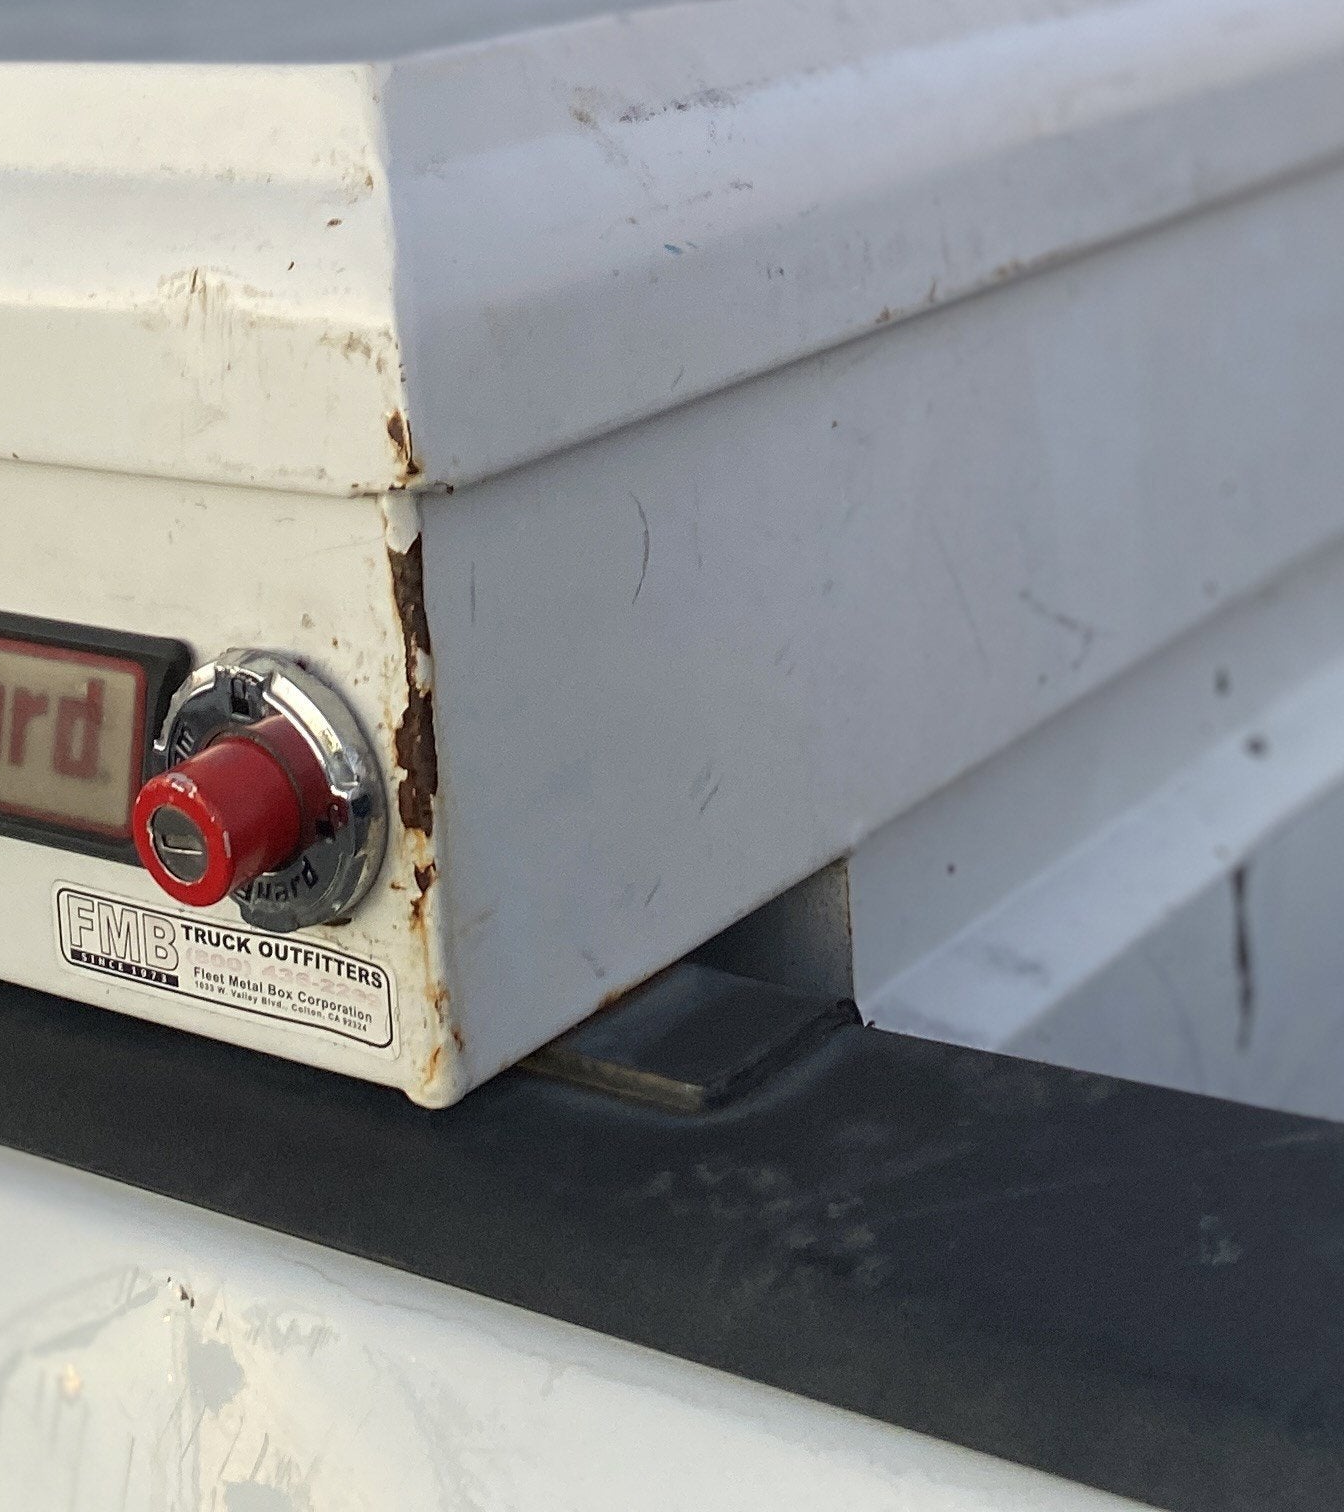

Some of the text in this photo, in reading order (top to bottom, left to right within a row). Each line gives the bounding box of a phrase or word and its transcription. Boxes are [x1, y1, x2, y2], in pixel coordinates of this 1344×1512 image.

[67, 894, 383, 989] FMB TRUCK OUTFITTERS
[81, 952, 124, 971] SINCE
[193, 966, 372, 1024] Fleet Metal Box Corporation
[328, 1012, 341, 1023] CA
